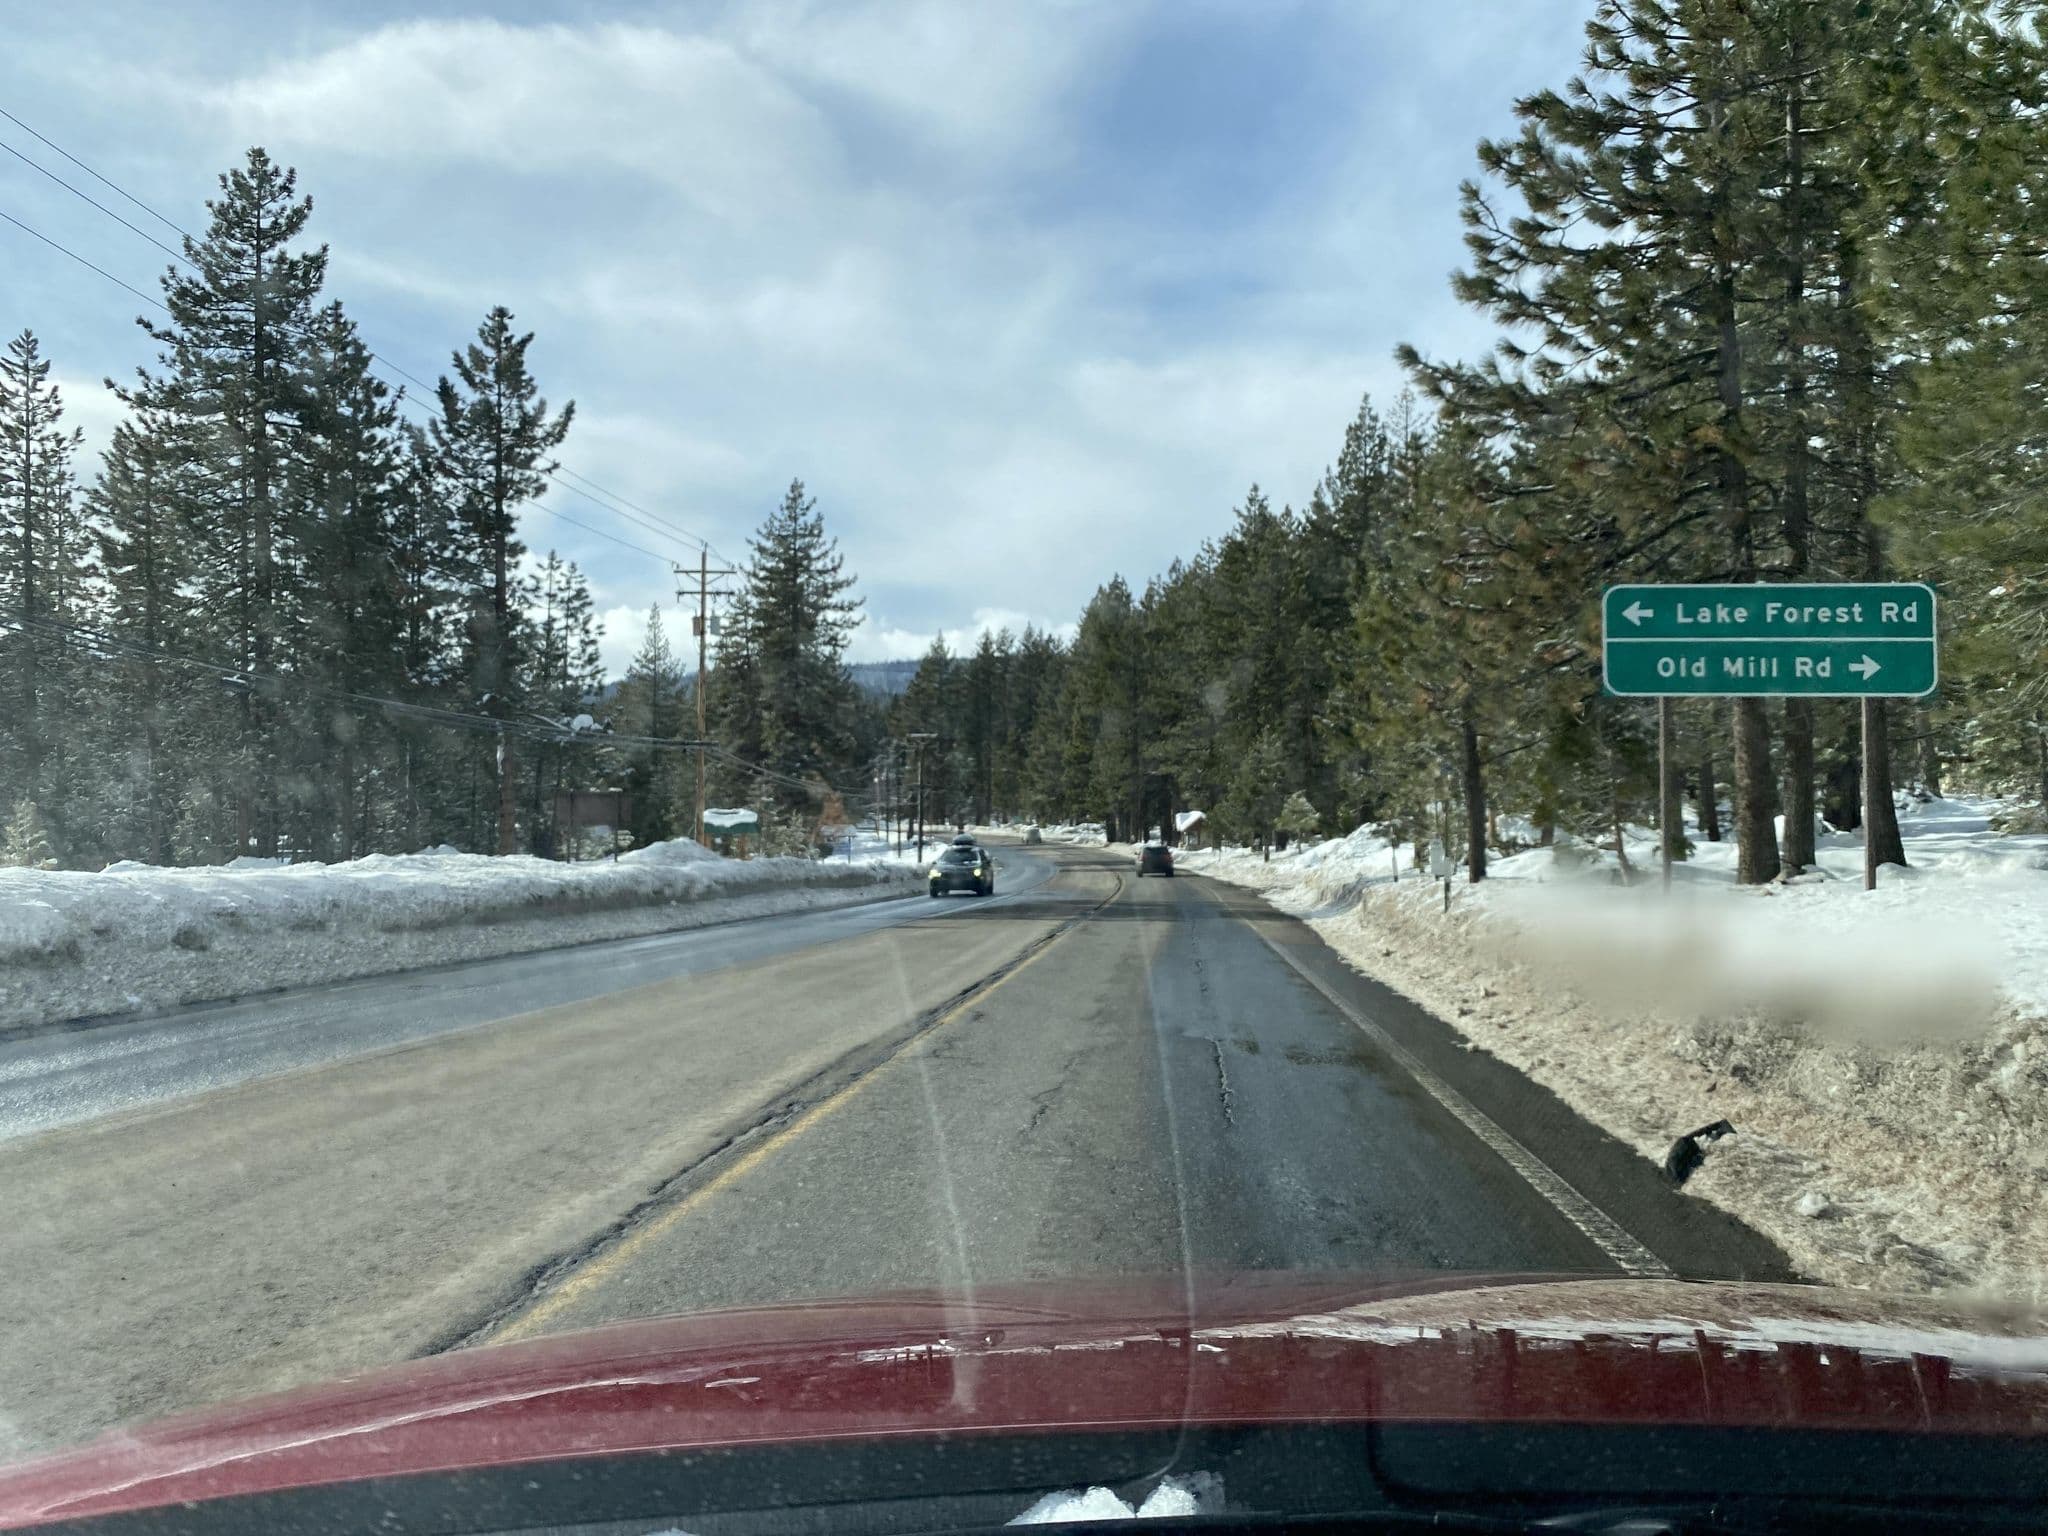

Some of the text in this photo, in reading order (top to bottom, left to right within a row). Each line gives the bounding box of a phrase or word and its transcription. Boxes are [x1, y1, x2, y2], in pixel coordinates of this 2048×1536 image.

[1676, 602, 1918, 623] Lake Forest Rd
[1656, 656, 1832, 678] Old Mill Rd
